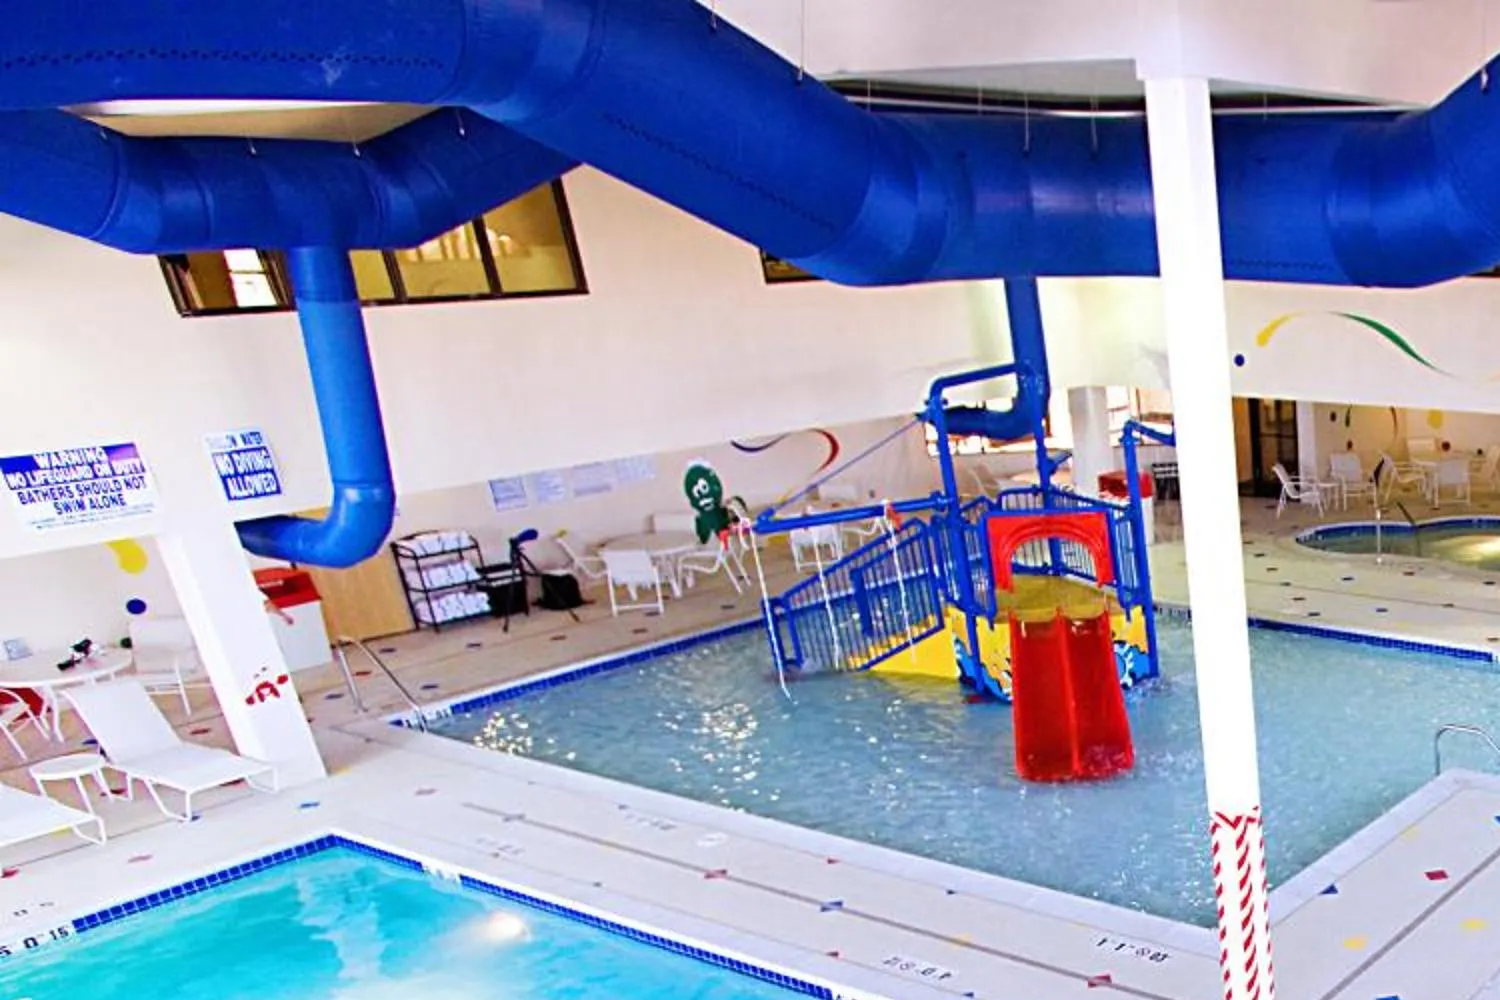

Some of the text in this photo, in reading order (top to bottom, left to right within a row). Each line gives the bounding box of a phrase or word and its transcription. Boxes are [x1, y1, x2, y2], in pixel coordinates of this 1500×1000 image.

[33, 447, 107, 469] WARNING
[213, 448, 272, 475] NO DIVING
[5, 471, 27, 490] NO
[28, 465, 93, 486] LIFEGUARD
[93, 463, 113, 479] ON
[227, 474, 278, 499] ALLOWED
[17, 475, 147, 505] BATHERS SHOULD NOT
[54, 493, 126, 515] SWIM ALONE
